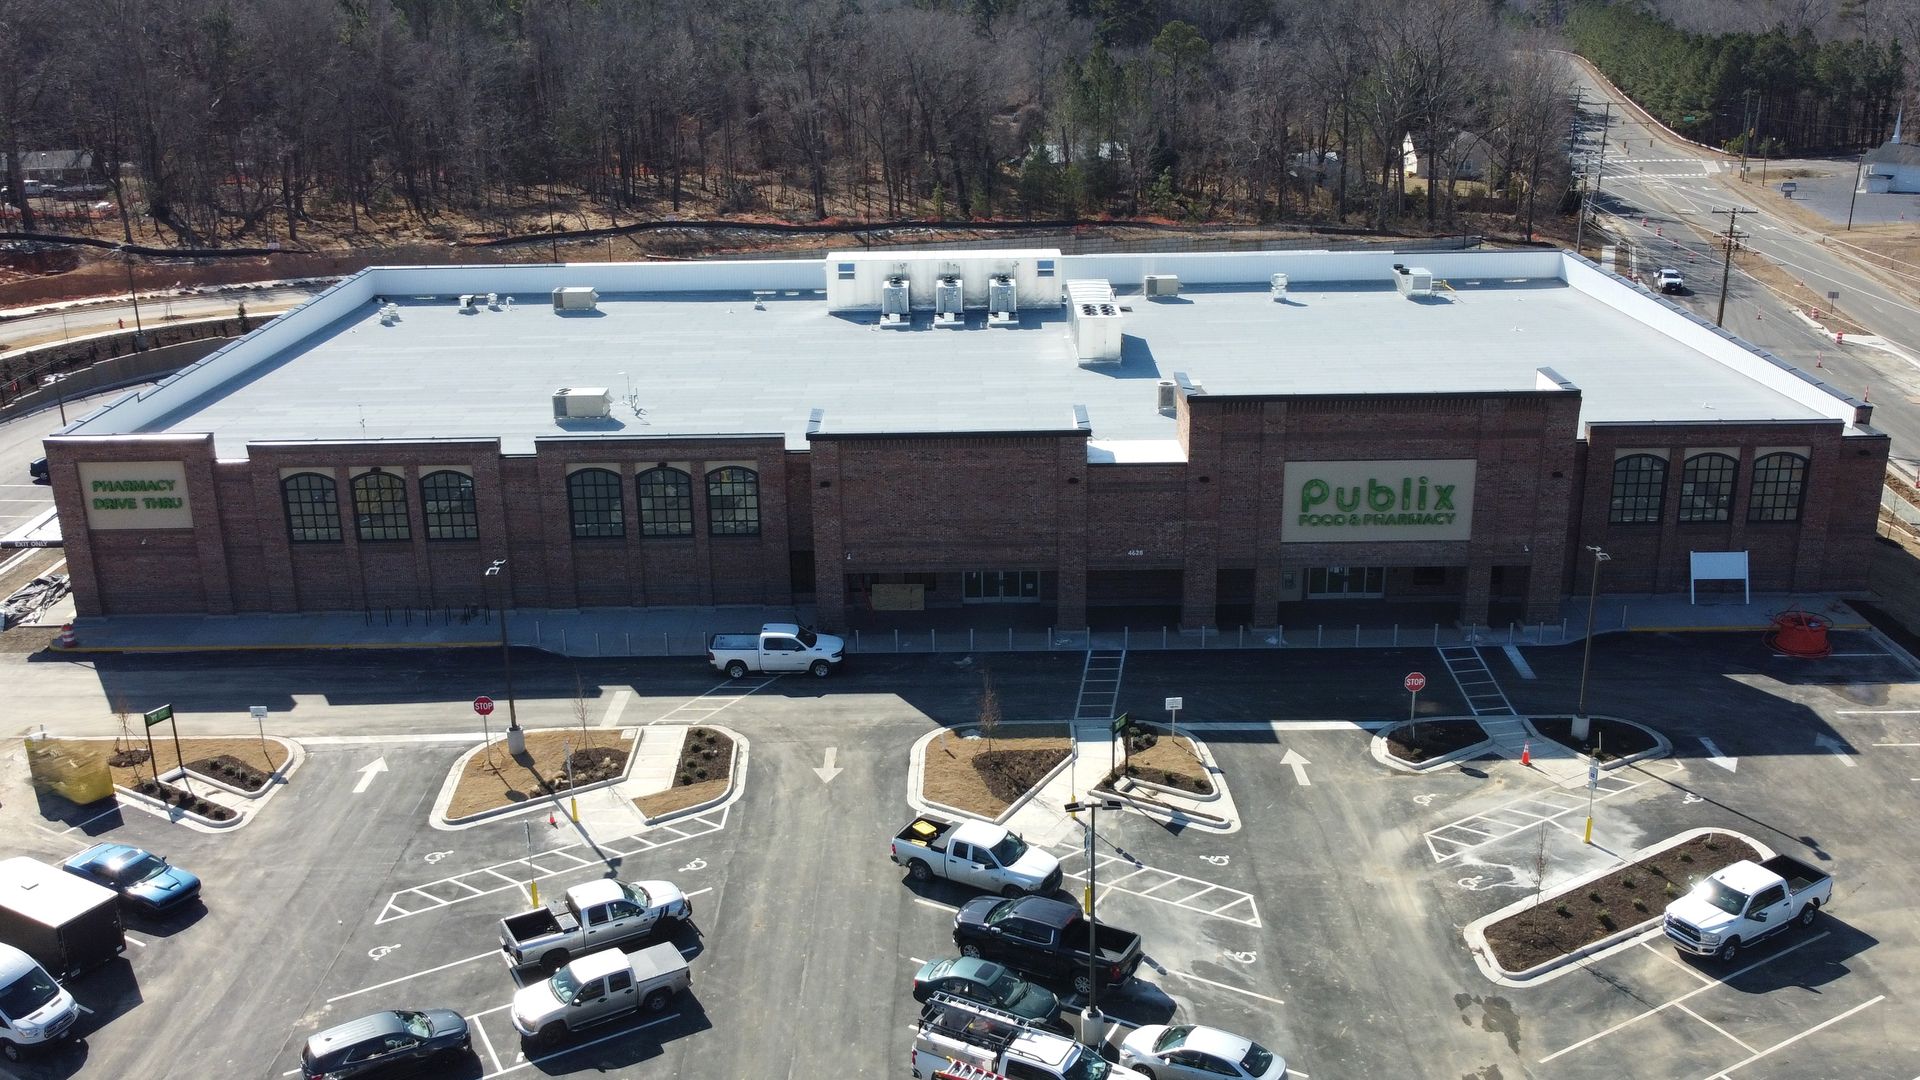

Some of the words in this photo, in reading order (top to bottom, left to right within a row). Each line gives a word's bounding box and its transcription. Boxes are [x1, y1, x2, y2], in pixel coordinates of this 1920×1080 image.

[92, 479, 176, 492] PHARMACY
[1301, 476, 1456, 512] Publix
[93, 497, 138, 510] DRIVE
[142, 497, 183, 509] THRU
[1298, 513, 1347, 527] FOOD
[1348, 514, 1361, 526] &
[1363, 512, 1457, 526] PHARMACY
[474, 702, 493, 710] STOP
